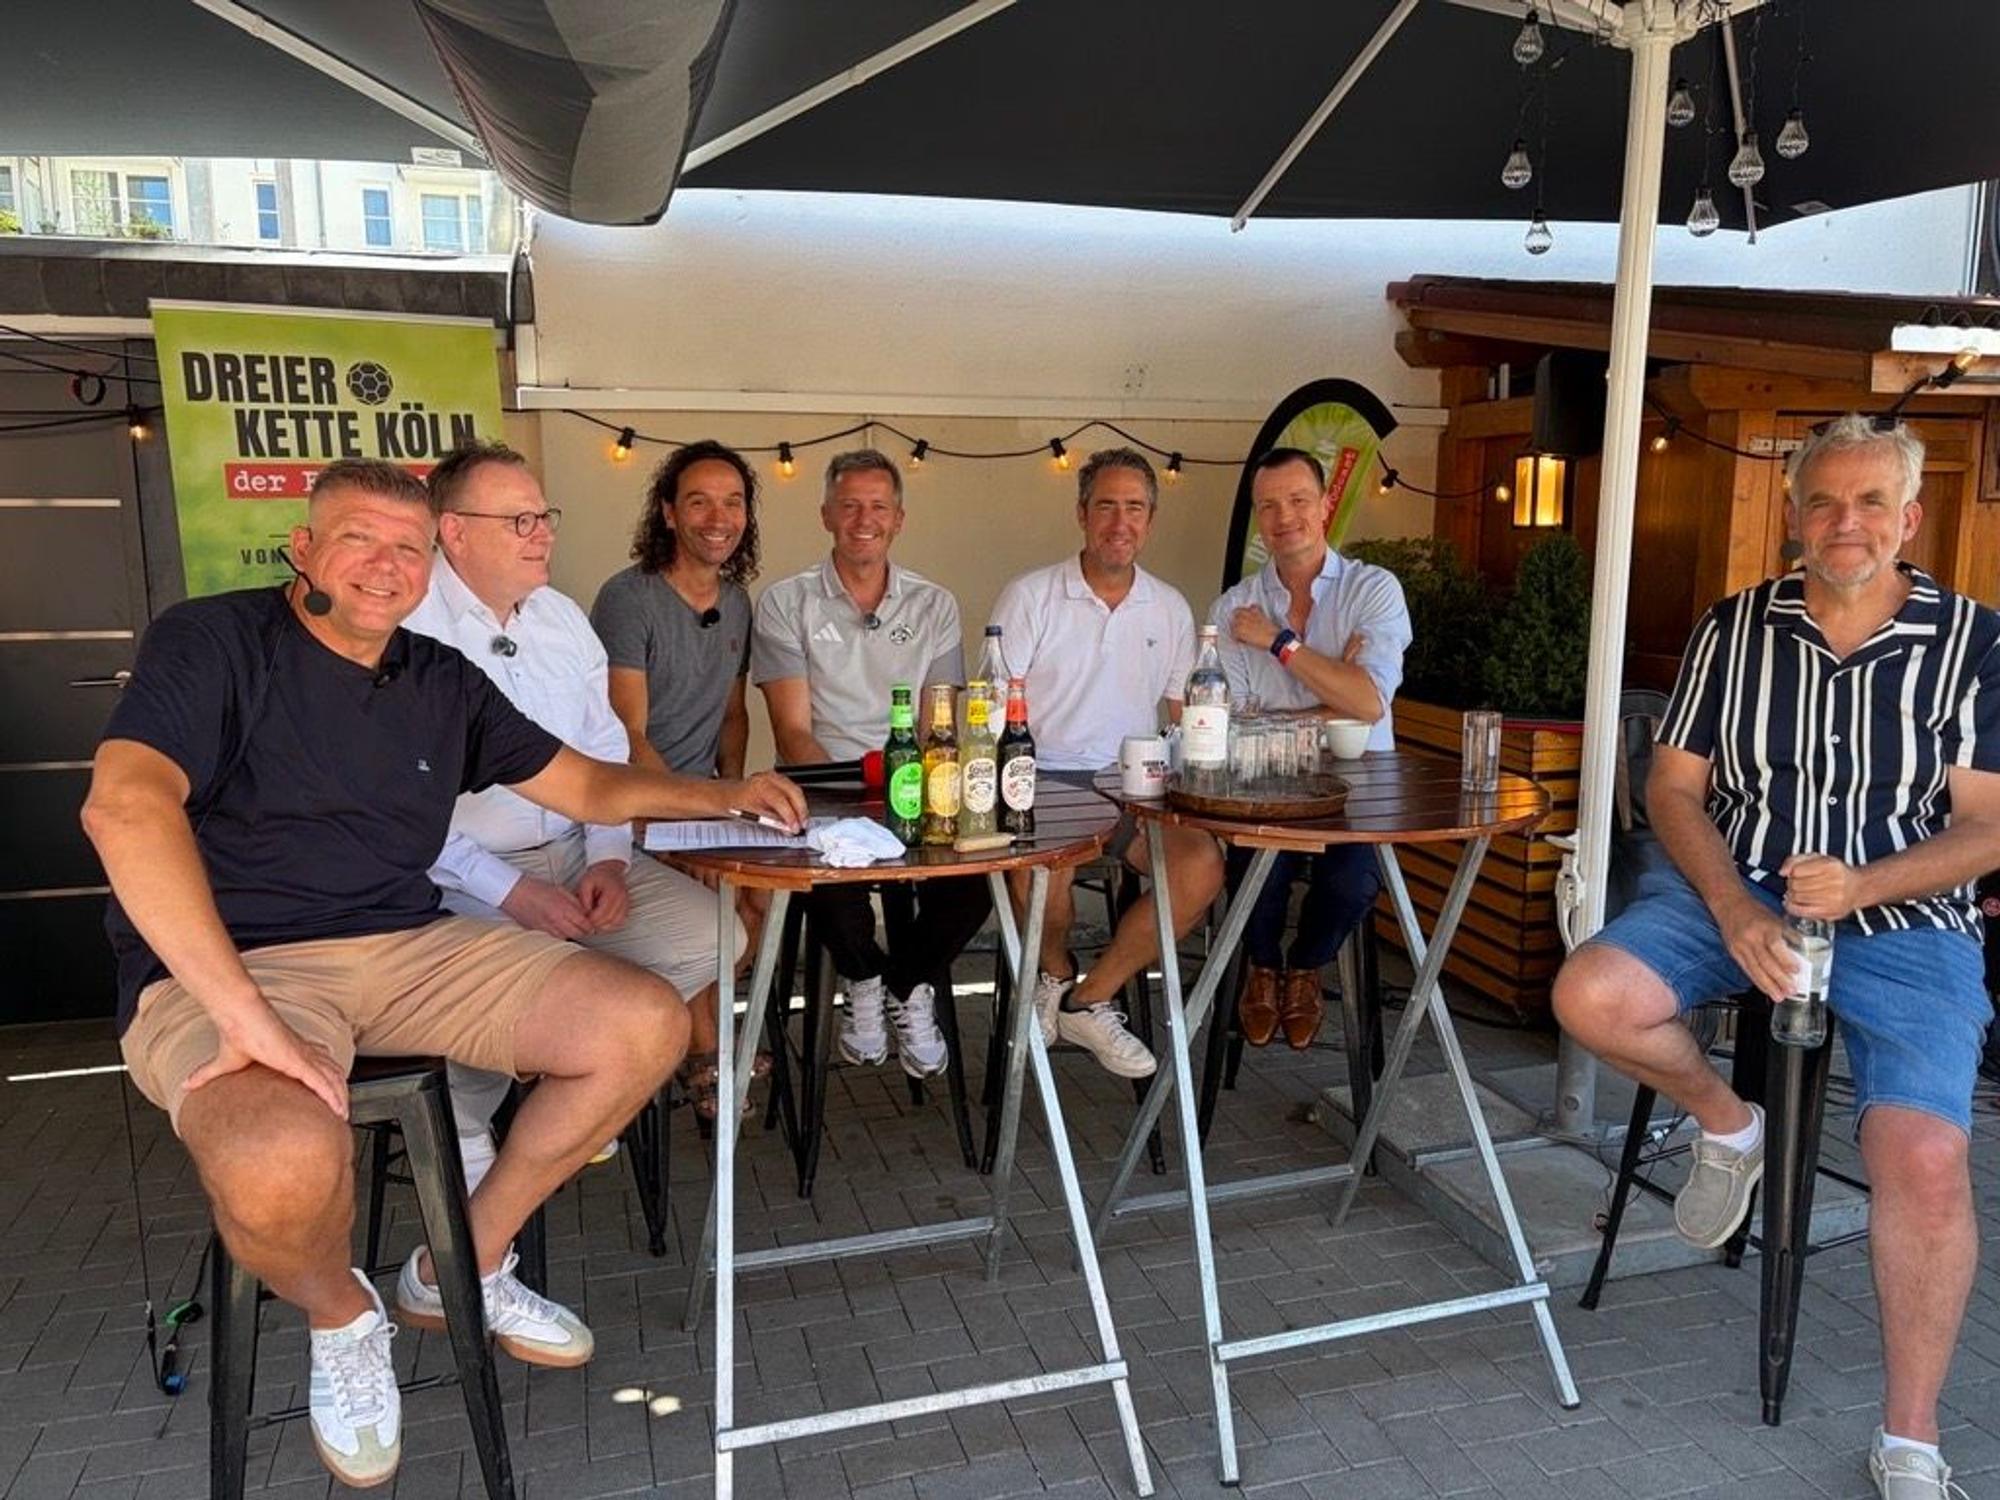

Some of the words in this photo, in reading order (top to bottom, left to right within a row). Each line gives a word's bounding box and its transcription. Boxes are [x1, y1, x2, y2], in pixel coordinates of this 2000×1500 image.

[181, 351, 338, 405] DREIER
[234, 408, 363, 458] KETTE
[375, 402, 476, 459] KÖLN
[233, 470, 287, 492] der
[240, 548, 284, 565] VON
